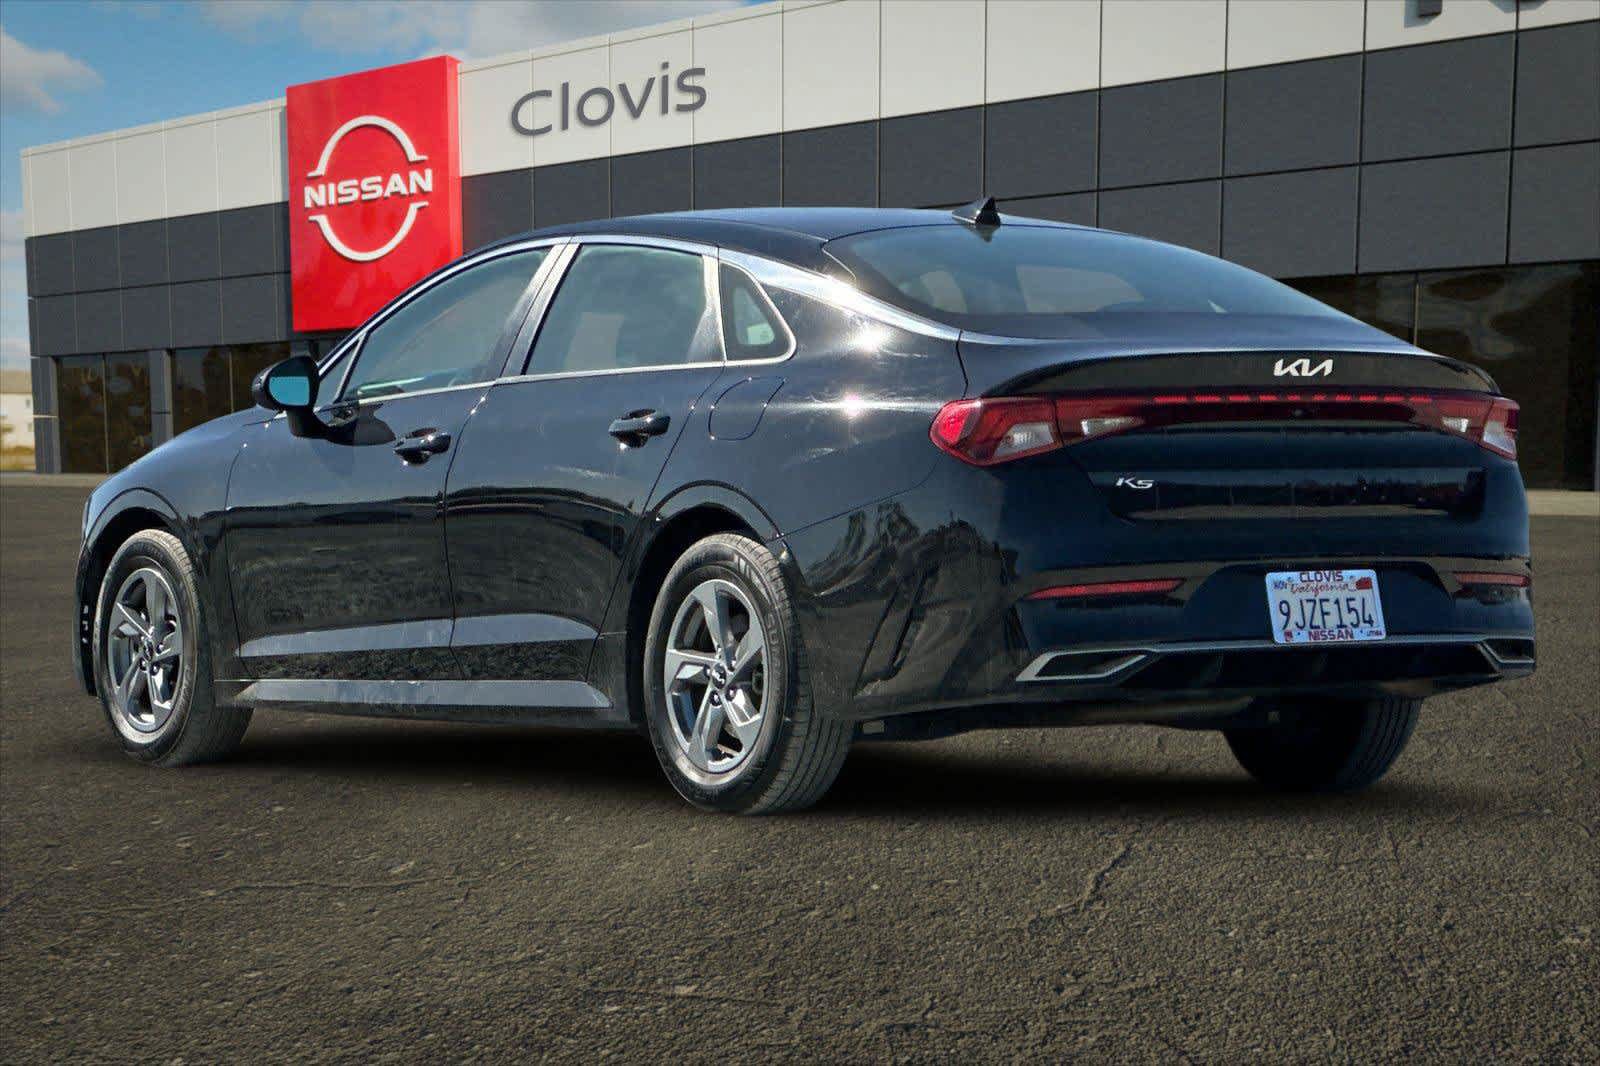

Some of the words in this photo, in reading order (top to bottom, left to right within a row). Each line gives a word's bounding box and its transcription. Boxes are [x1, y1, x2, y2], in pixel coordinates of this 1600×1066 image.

[510, 62, 708, 136] Clovis
[304, 168, 433, 209] NISSAN
[1273, 358, 1334, 377] KIA
[1115, 476, 1155, 489] K5
[1299, 571, 1344, 583] CLOVIS
[1290, 582, 1349, 597] California
[1278, 597, 1375, 631] 9JZF154
[1307, 628, 1355, 641] NISSAN
